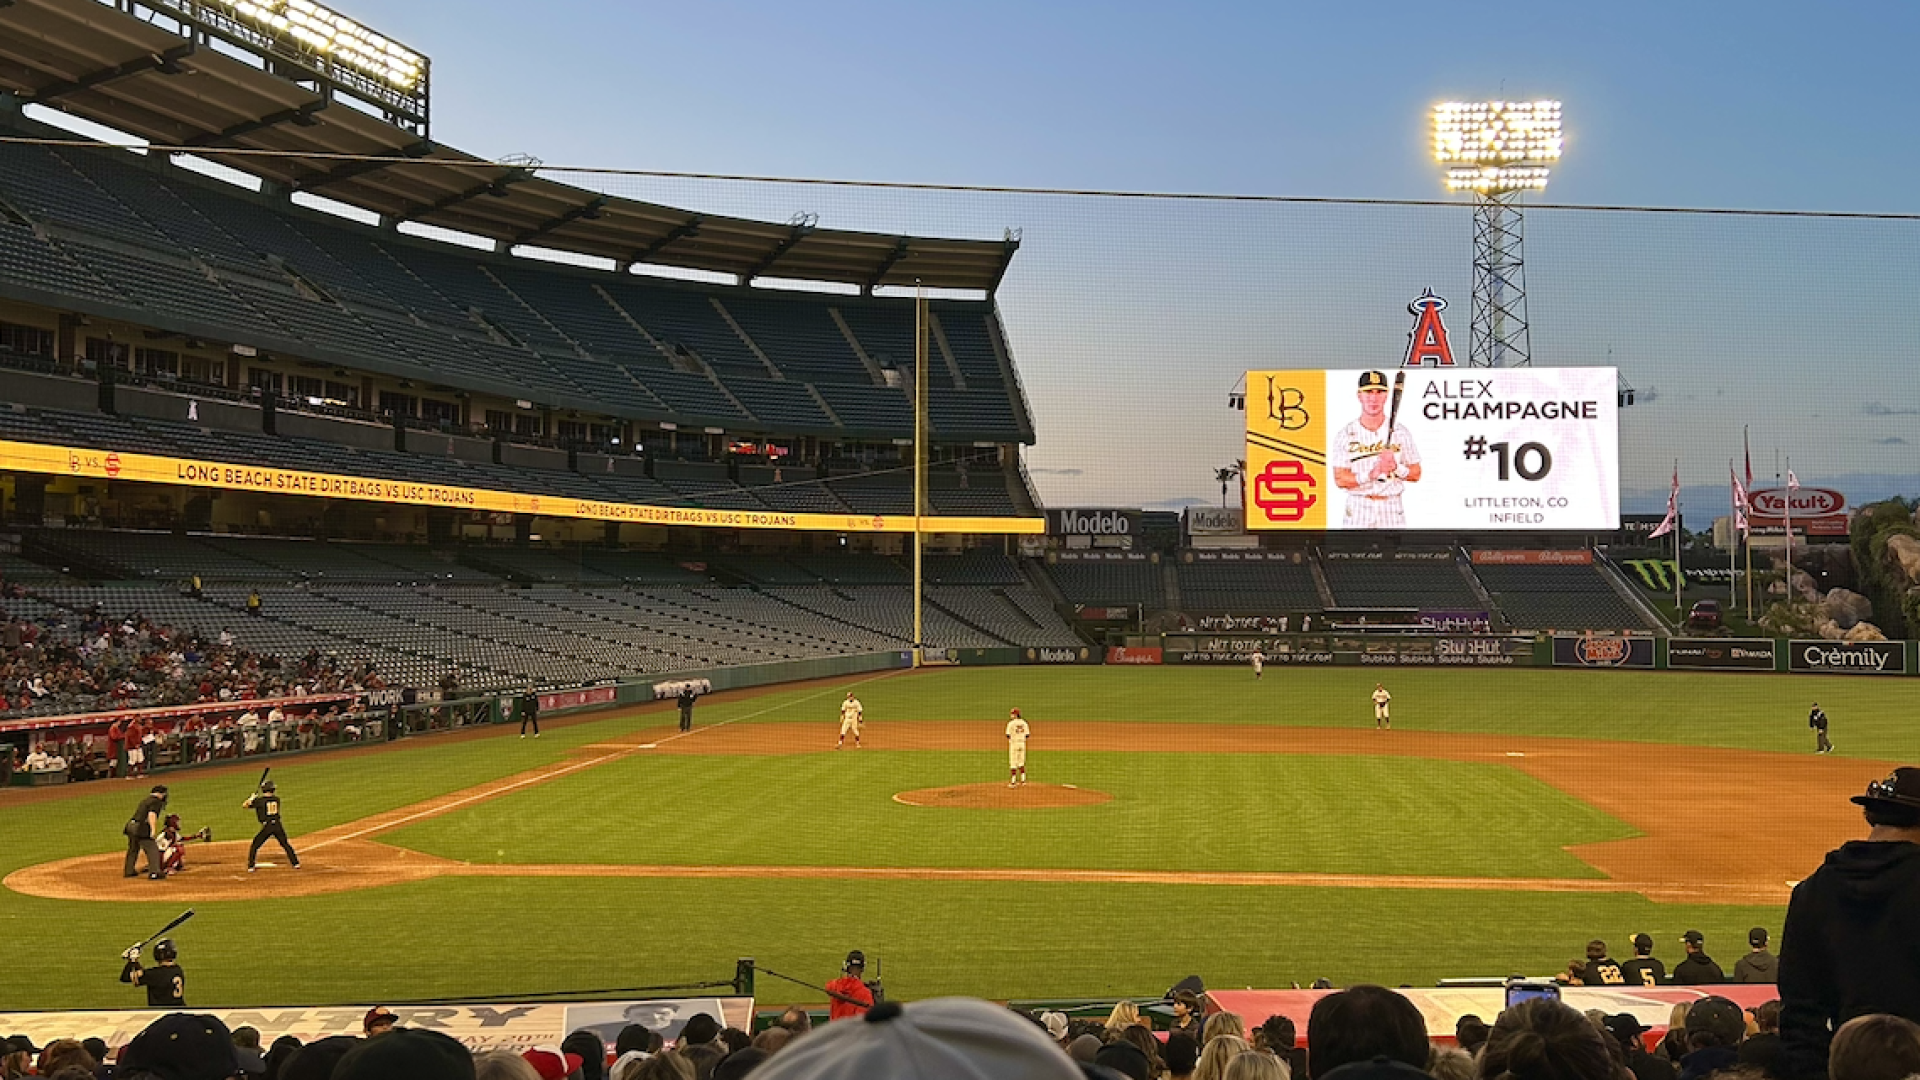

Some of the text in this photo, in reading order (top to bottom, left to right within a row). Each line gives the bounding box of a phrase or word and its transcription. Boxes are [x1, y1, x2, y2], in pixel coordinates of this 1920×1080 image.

[1422, 380, 1494, 399] ALEX
[1422, 401, 1598, 420] CHAMPAGNE
[1463, 435, 1552, 482] #10
[178, 463, 475, 504] LONG BEACH STATE DIRTBAGS VS USC TROJANS
[1464, 497, 1569, 509] LITTLETON, CO
[1761, 495, 1830, 509] Yakult
[576, 503, 796, 526] LONG BEACH STATE DIRTBAGS VS USC TROJANS
[1060, 510, 1129, 534] Modelo
[1193, 512, 1236, 528] Modelo
[1489, 513, 1545, 523] INFIELD
[1040, 648, 1076, 662] Modelo
[266, 801, 278, 815] 10
[1597, 965, 1625, 984] 22
[1639, 968, 1656, 989] 5
[172, 976, 183, 998] 3
